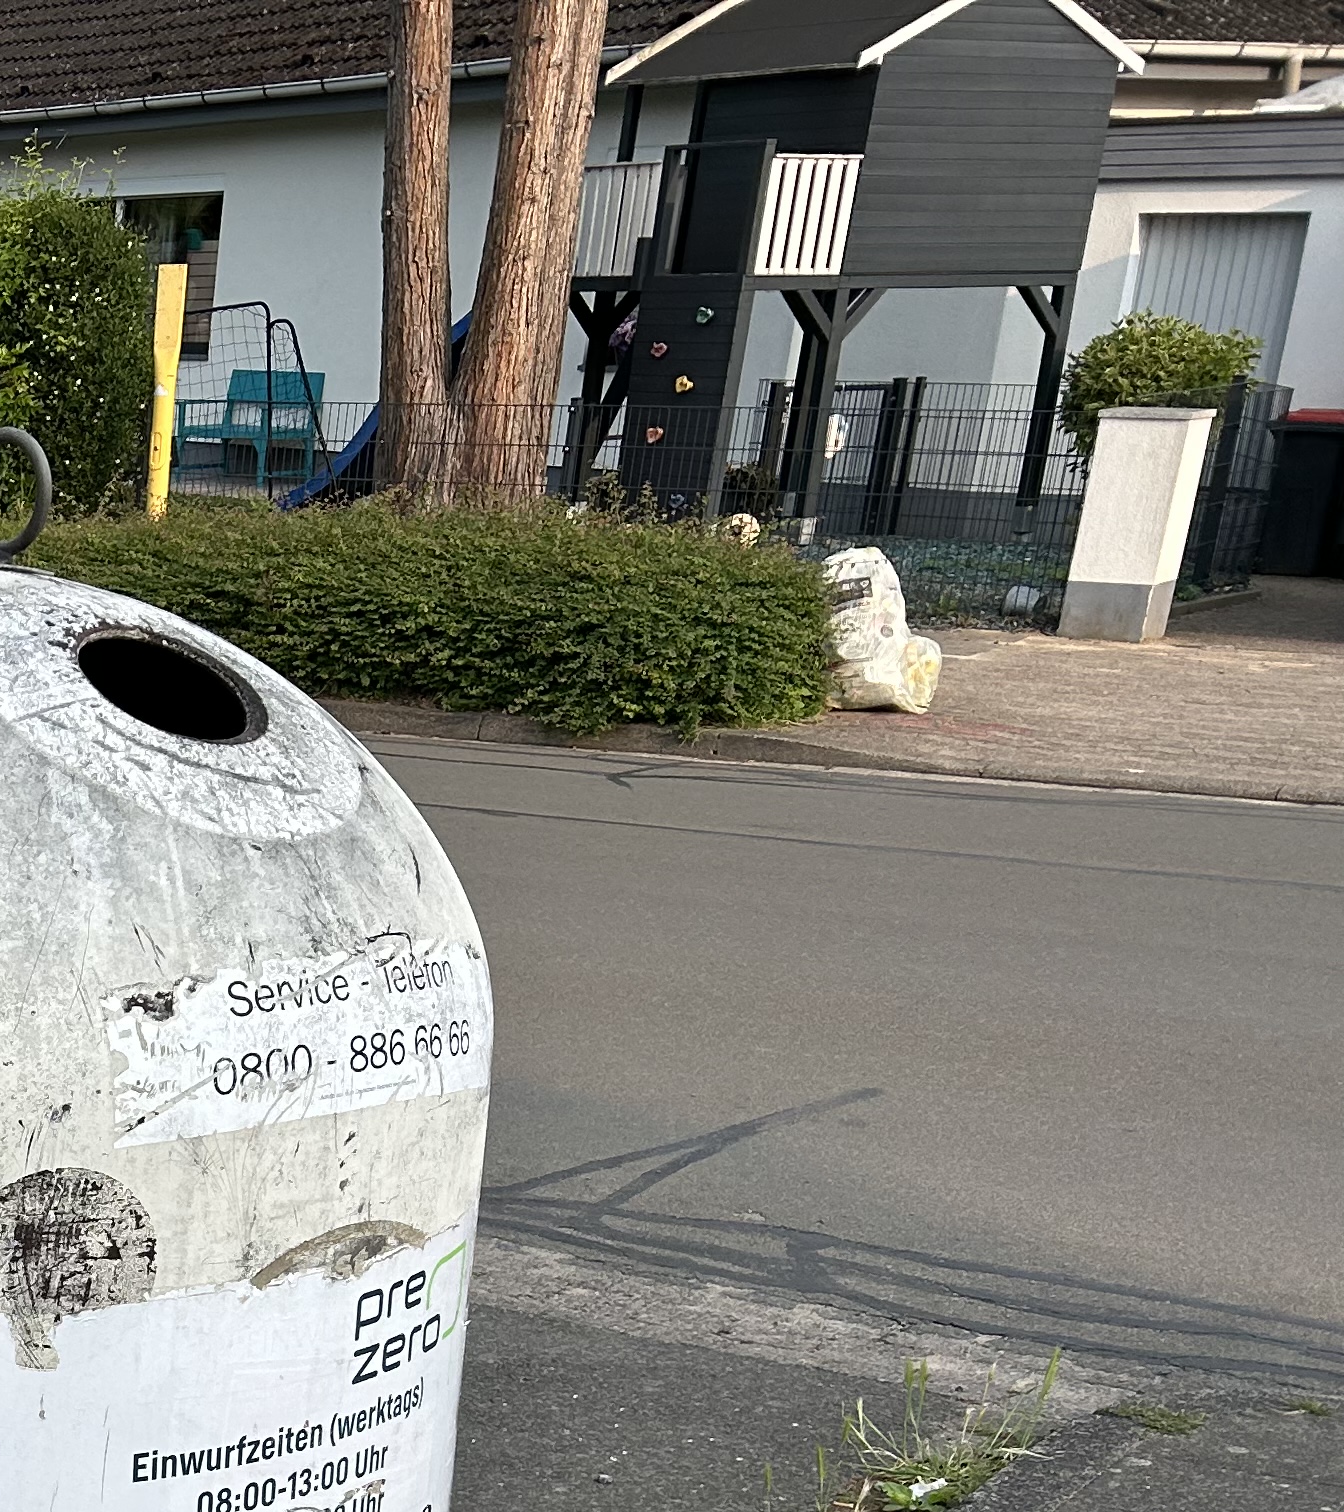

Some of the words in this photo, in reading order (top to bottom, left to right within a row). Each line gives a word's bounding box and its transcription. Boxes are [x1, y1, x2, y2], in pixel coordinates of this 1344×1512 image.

[226, 968, 350, 1018] Service
[212, 1043, 312, 1096] 0800
[349, 1028, 406, 1073] 886
[414, 1022, 443, 1060] 66
[448, 1018, 470, 1056] 66
[354, 1269, 426, 1341] pre
[351, 1313, 441, 1385] zero
[132, 1421, 323, 1483] Einwurfzeiten
[330, 1376, 424, 1447] (werktags)
[355, 1443, 389, 1479] Uhr
